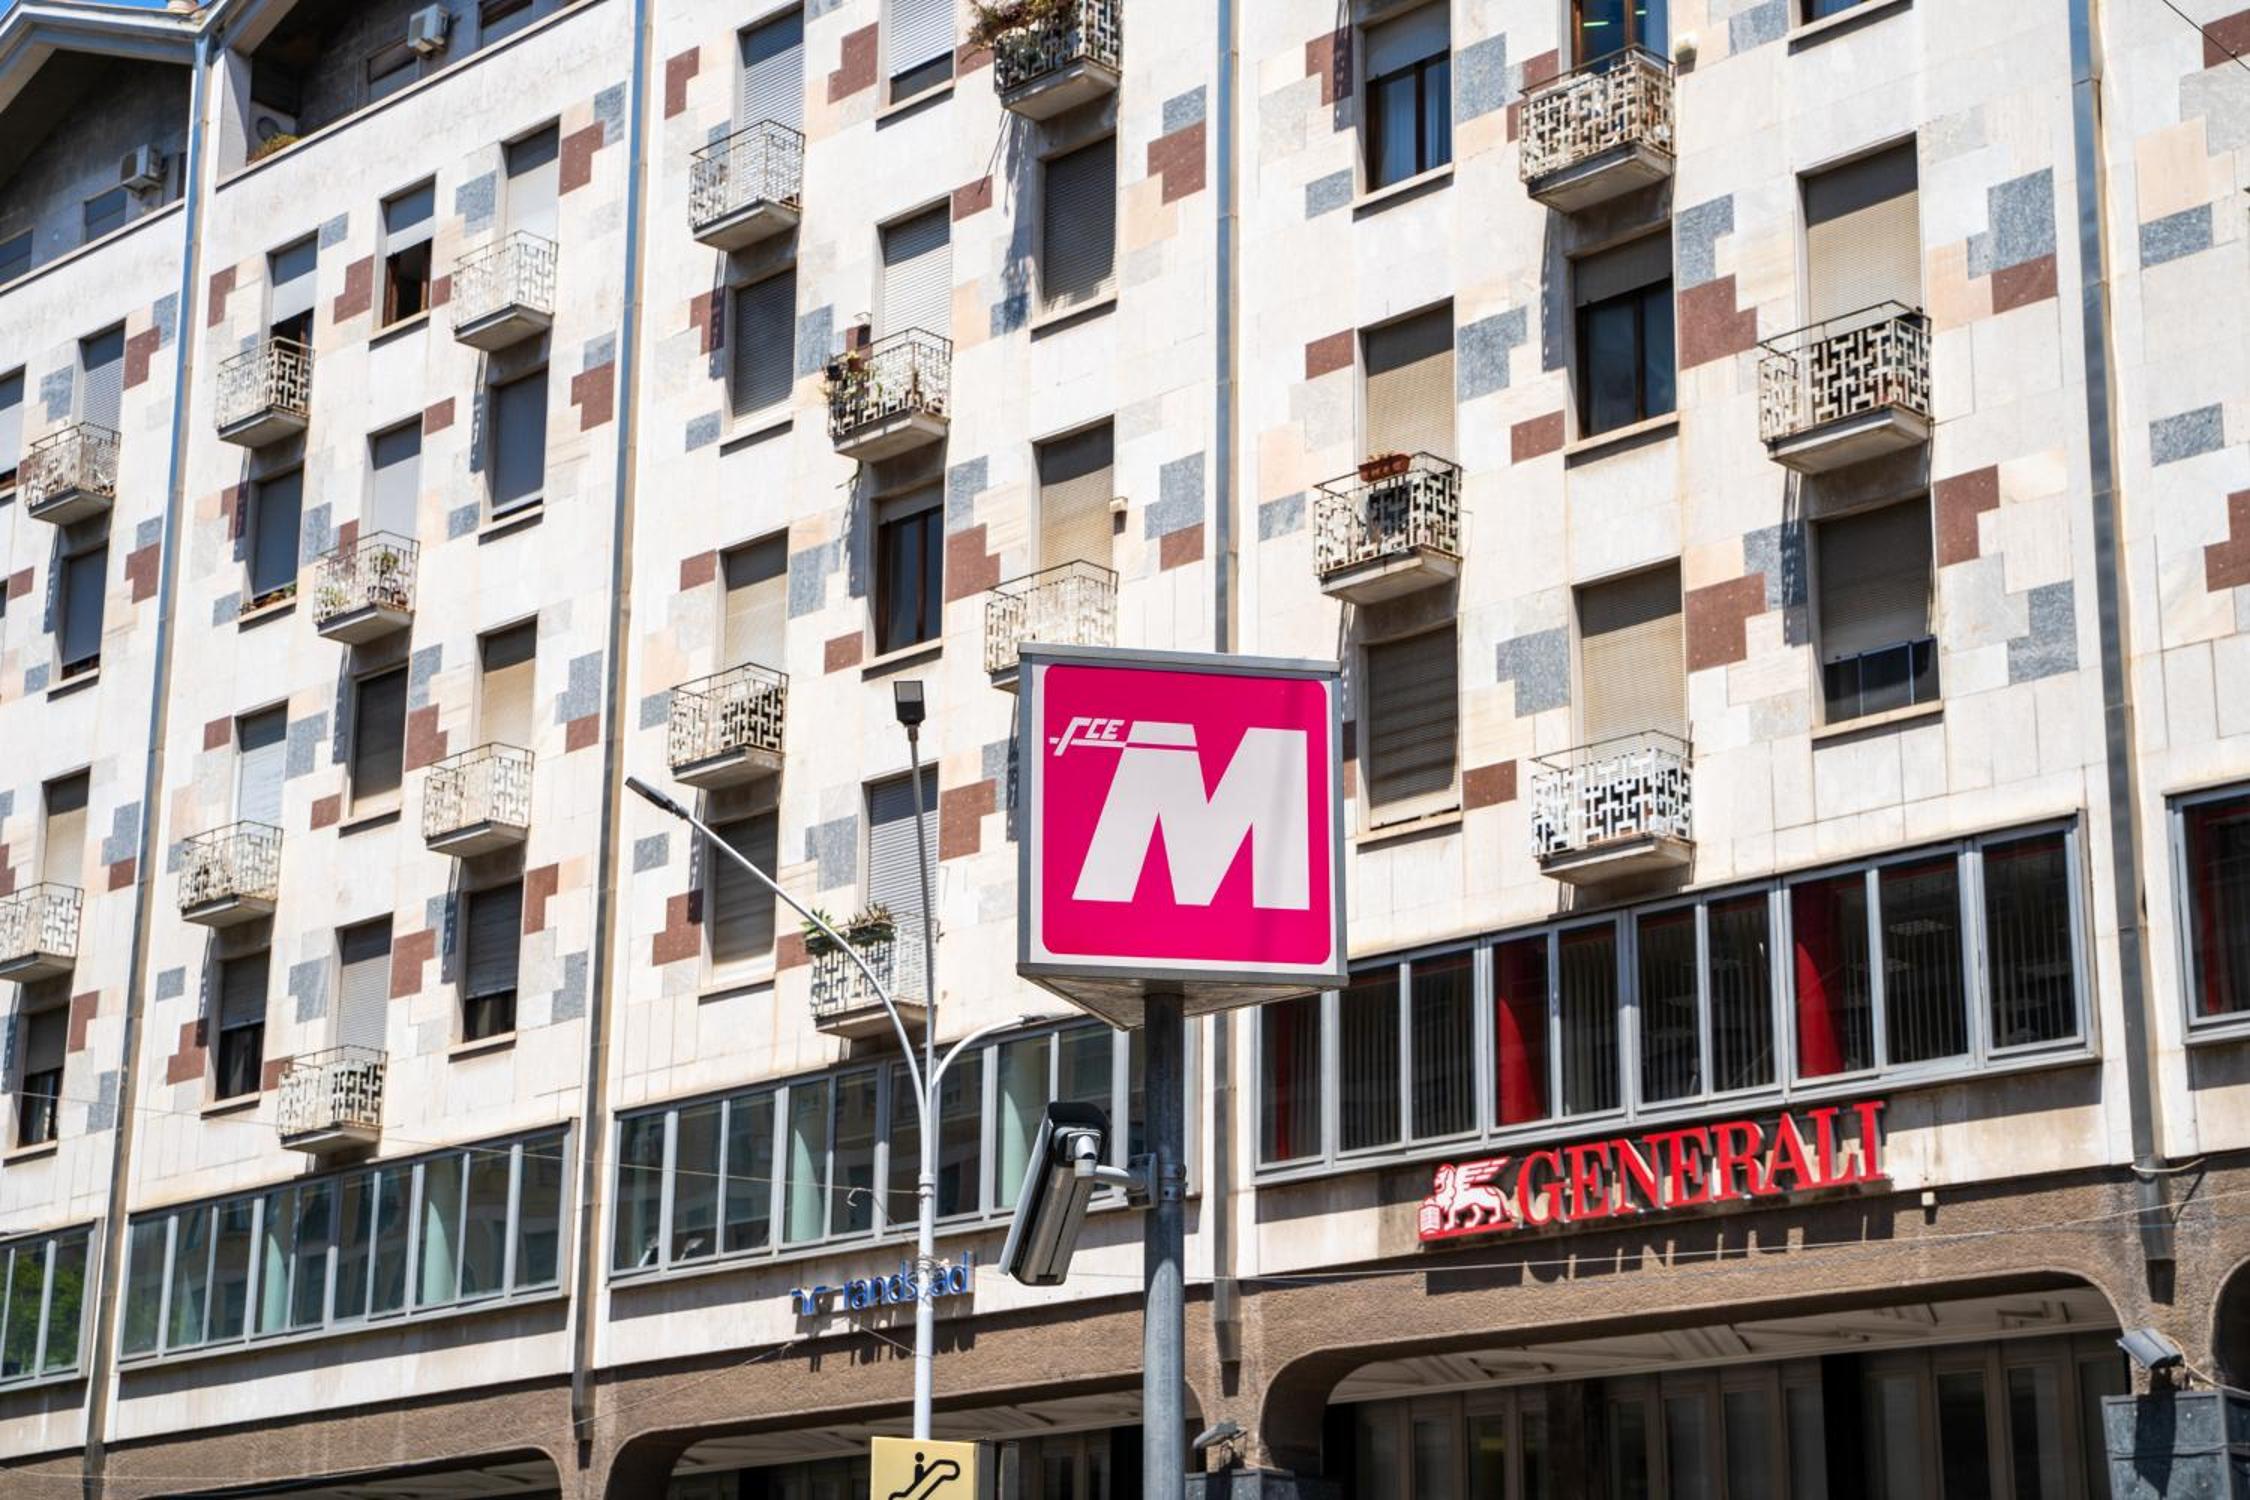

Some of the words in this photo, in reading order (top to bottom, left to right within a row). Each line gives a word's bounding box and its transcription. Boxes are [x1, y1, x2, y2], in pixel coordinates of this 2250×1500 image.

[1071, 719, 1311, 912] M
[1515, 1100, 1887, 1226] GENERALI
[843, 1250, 972, 1310] randsad
